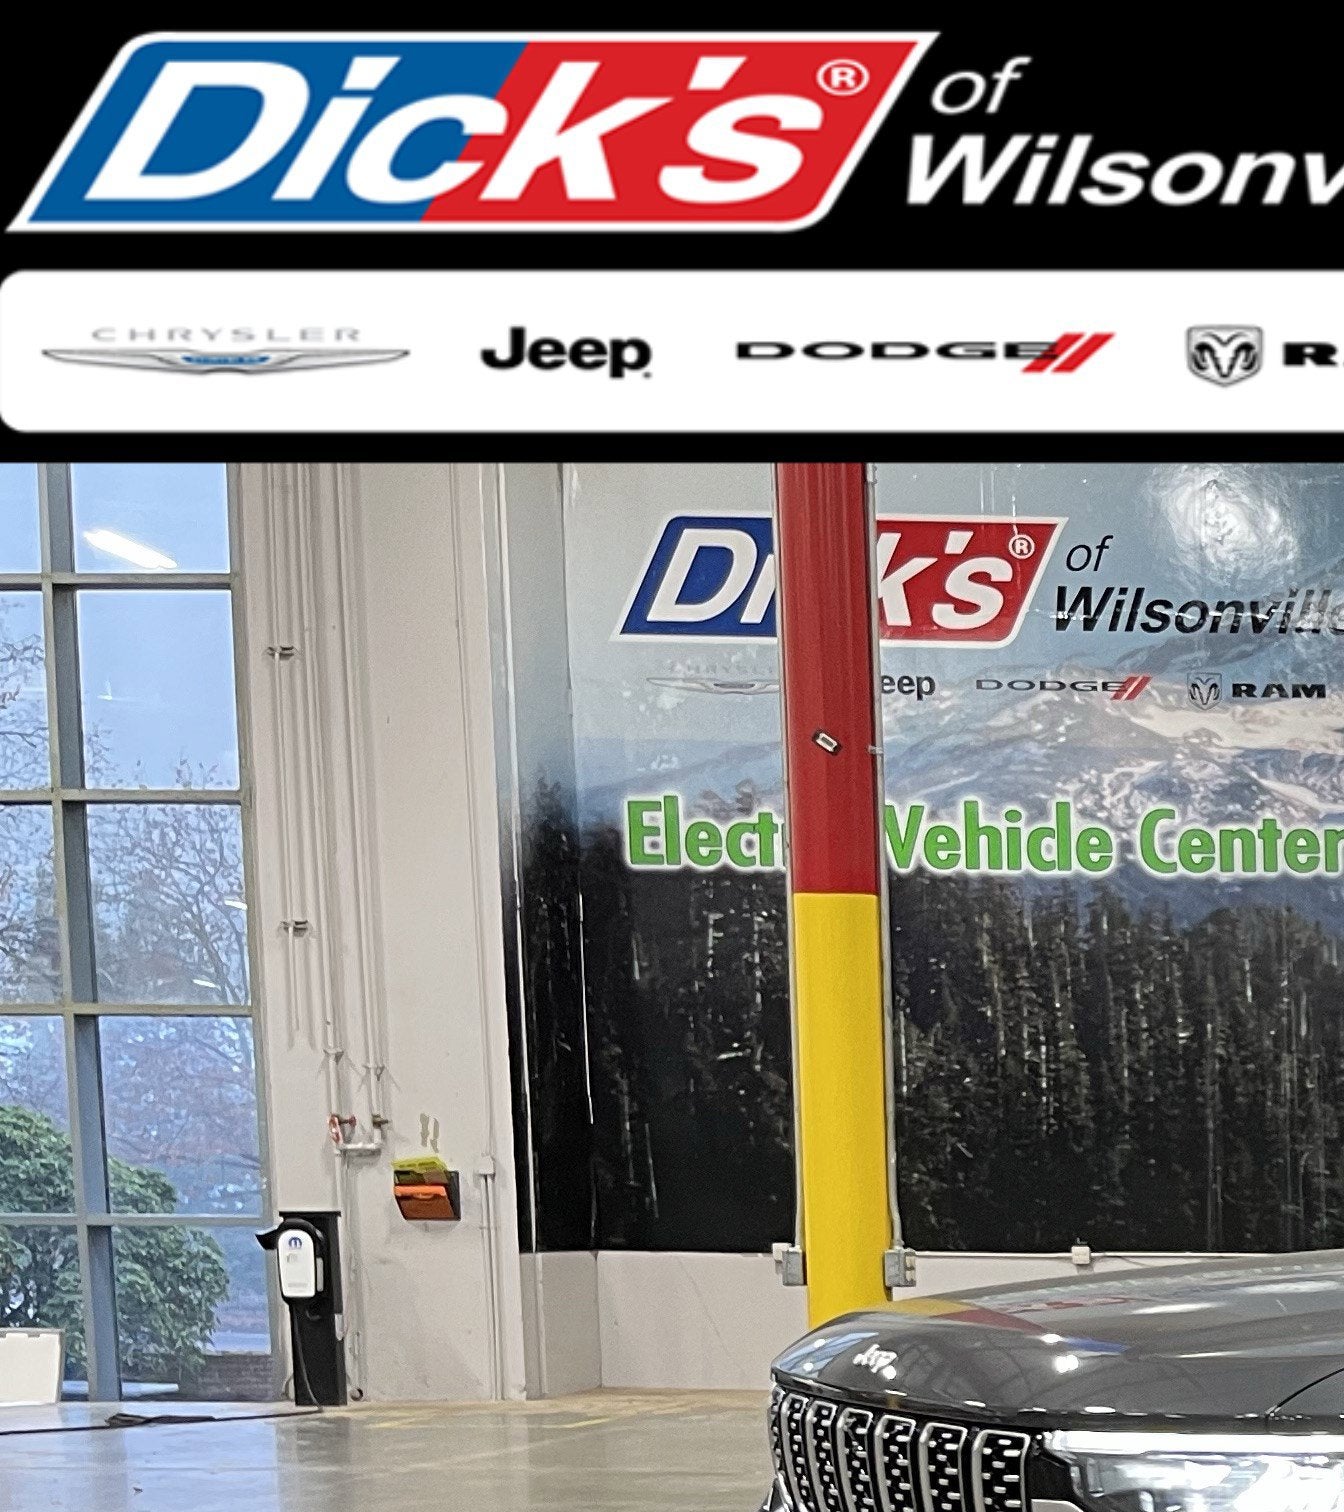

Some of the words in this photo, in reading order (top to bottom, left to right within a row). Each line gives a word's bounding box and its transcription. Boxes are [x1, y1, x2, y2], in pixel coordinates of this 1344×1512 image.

[1065, 534, 1114, 573] of
[646, 528, 1014, 631] Dk's
[880, 674, 937, 701] eep
[975, 678, 1128, 693] DODGE
[1231, 683, 1327, 699] RAM
[626, 795, 785, 867] Elect
[884, 800, 1114, 872] Vehicle
